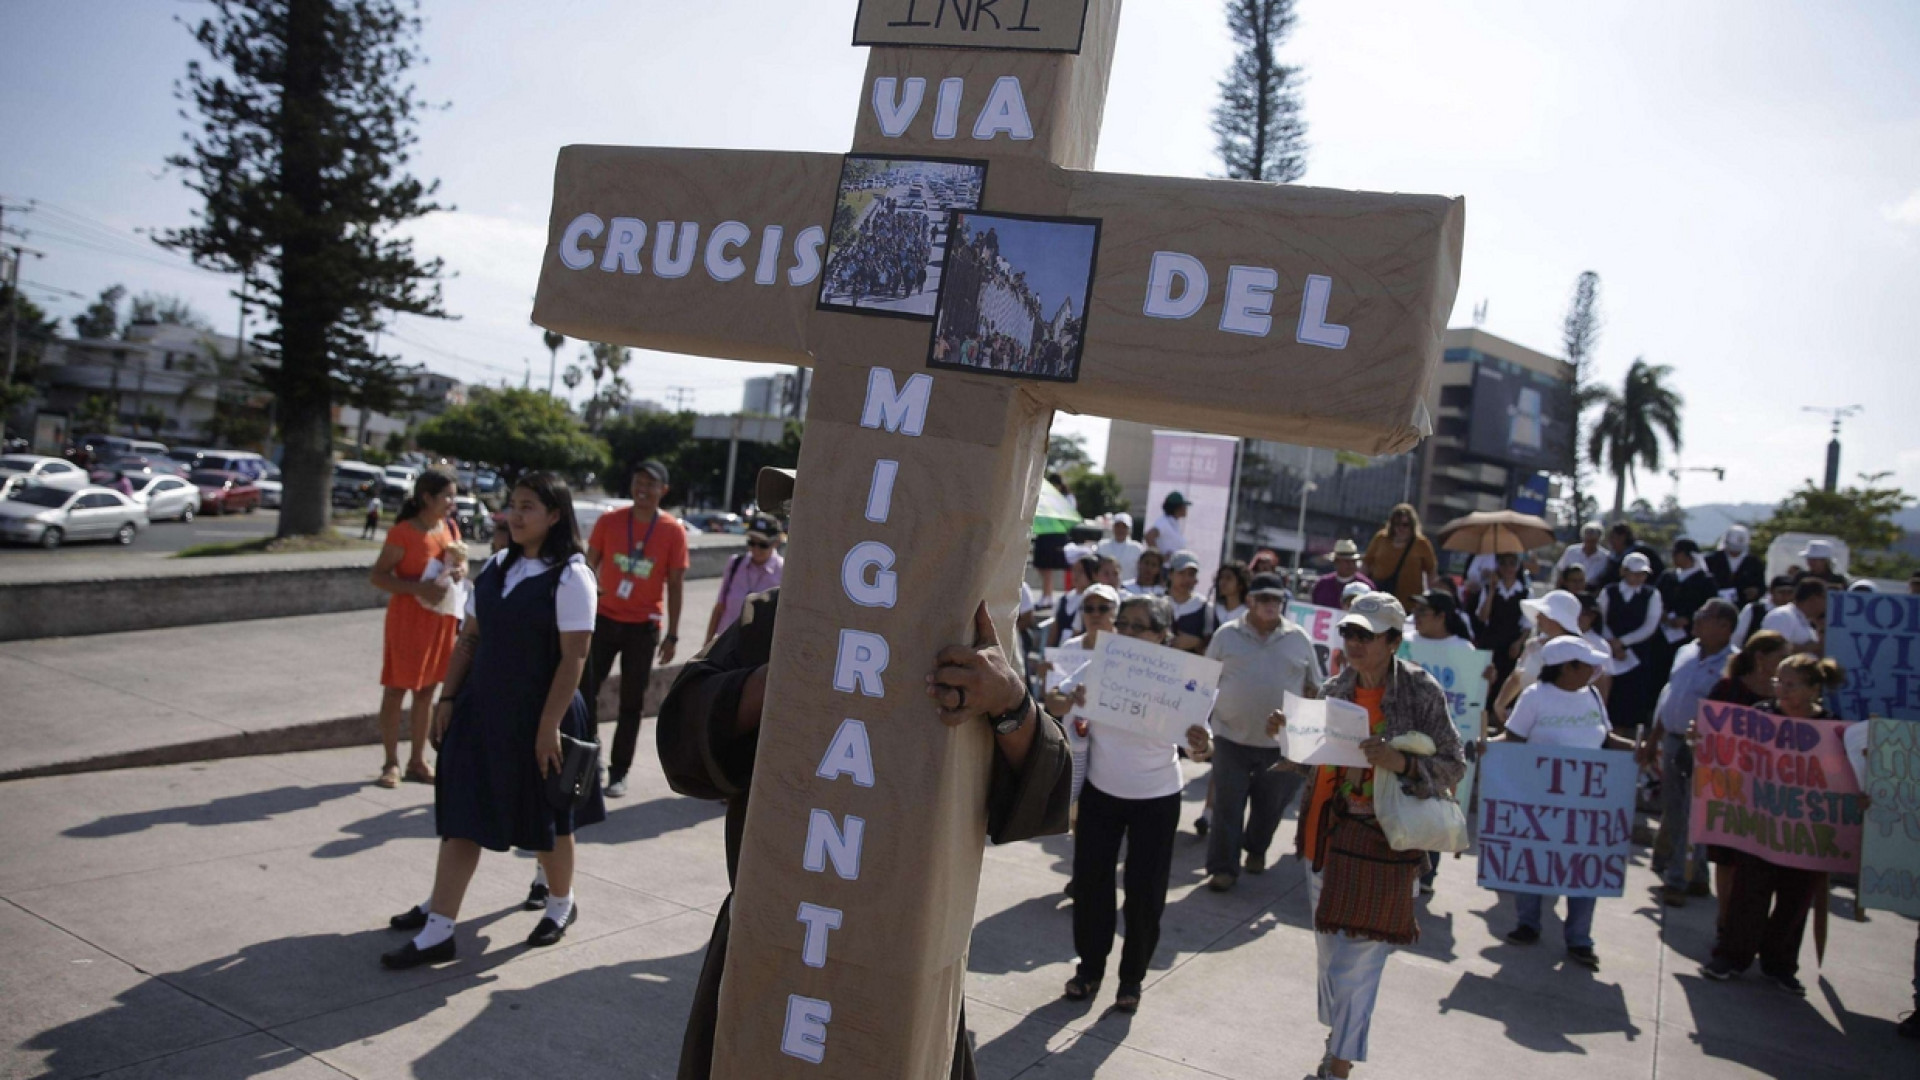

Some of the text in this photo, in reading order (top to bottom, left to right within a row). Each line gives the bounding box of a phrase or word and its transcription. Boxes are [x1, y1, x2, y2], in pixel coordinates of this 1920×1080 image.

[872, 76, 1034, 141] VIA
[559, 212, 826, 287] CRUCIS
[1143, 250, 1350, 349] DEL
[781, 366, 934, 1064] MIGRANTE
[1702, 704, 1821, 752] VERDAD
[1536, 756, 1608, 798] TE
[1694, 766, 1747, 804] POR
[1696, 733, 1828, 789] JUSTICIA
[1480, 798, 1632, 847] EXTRA
[1478, 837, 1627, 889] ÑAMOS
